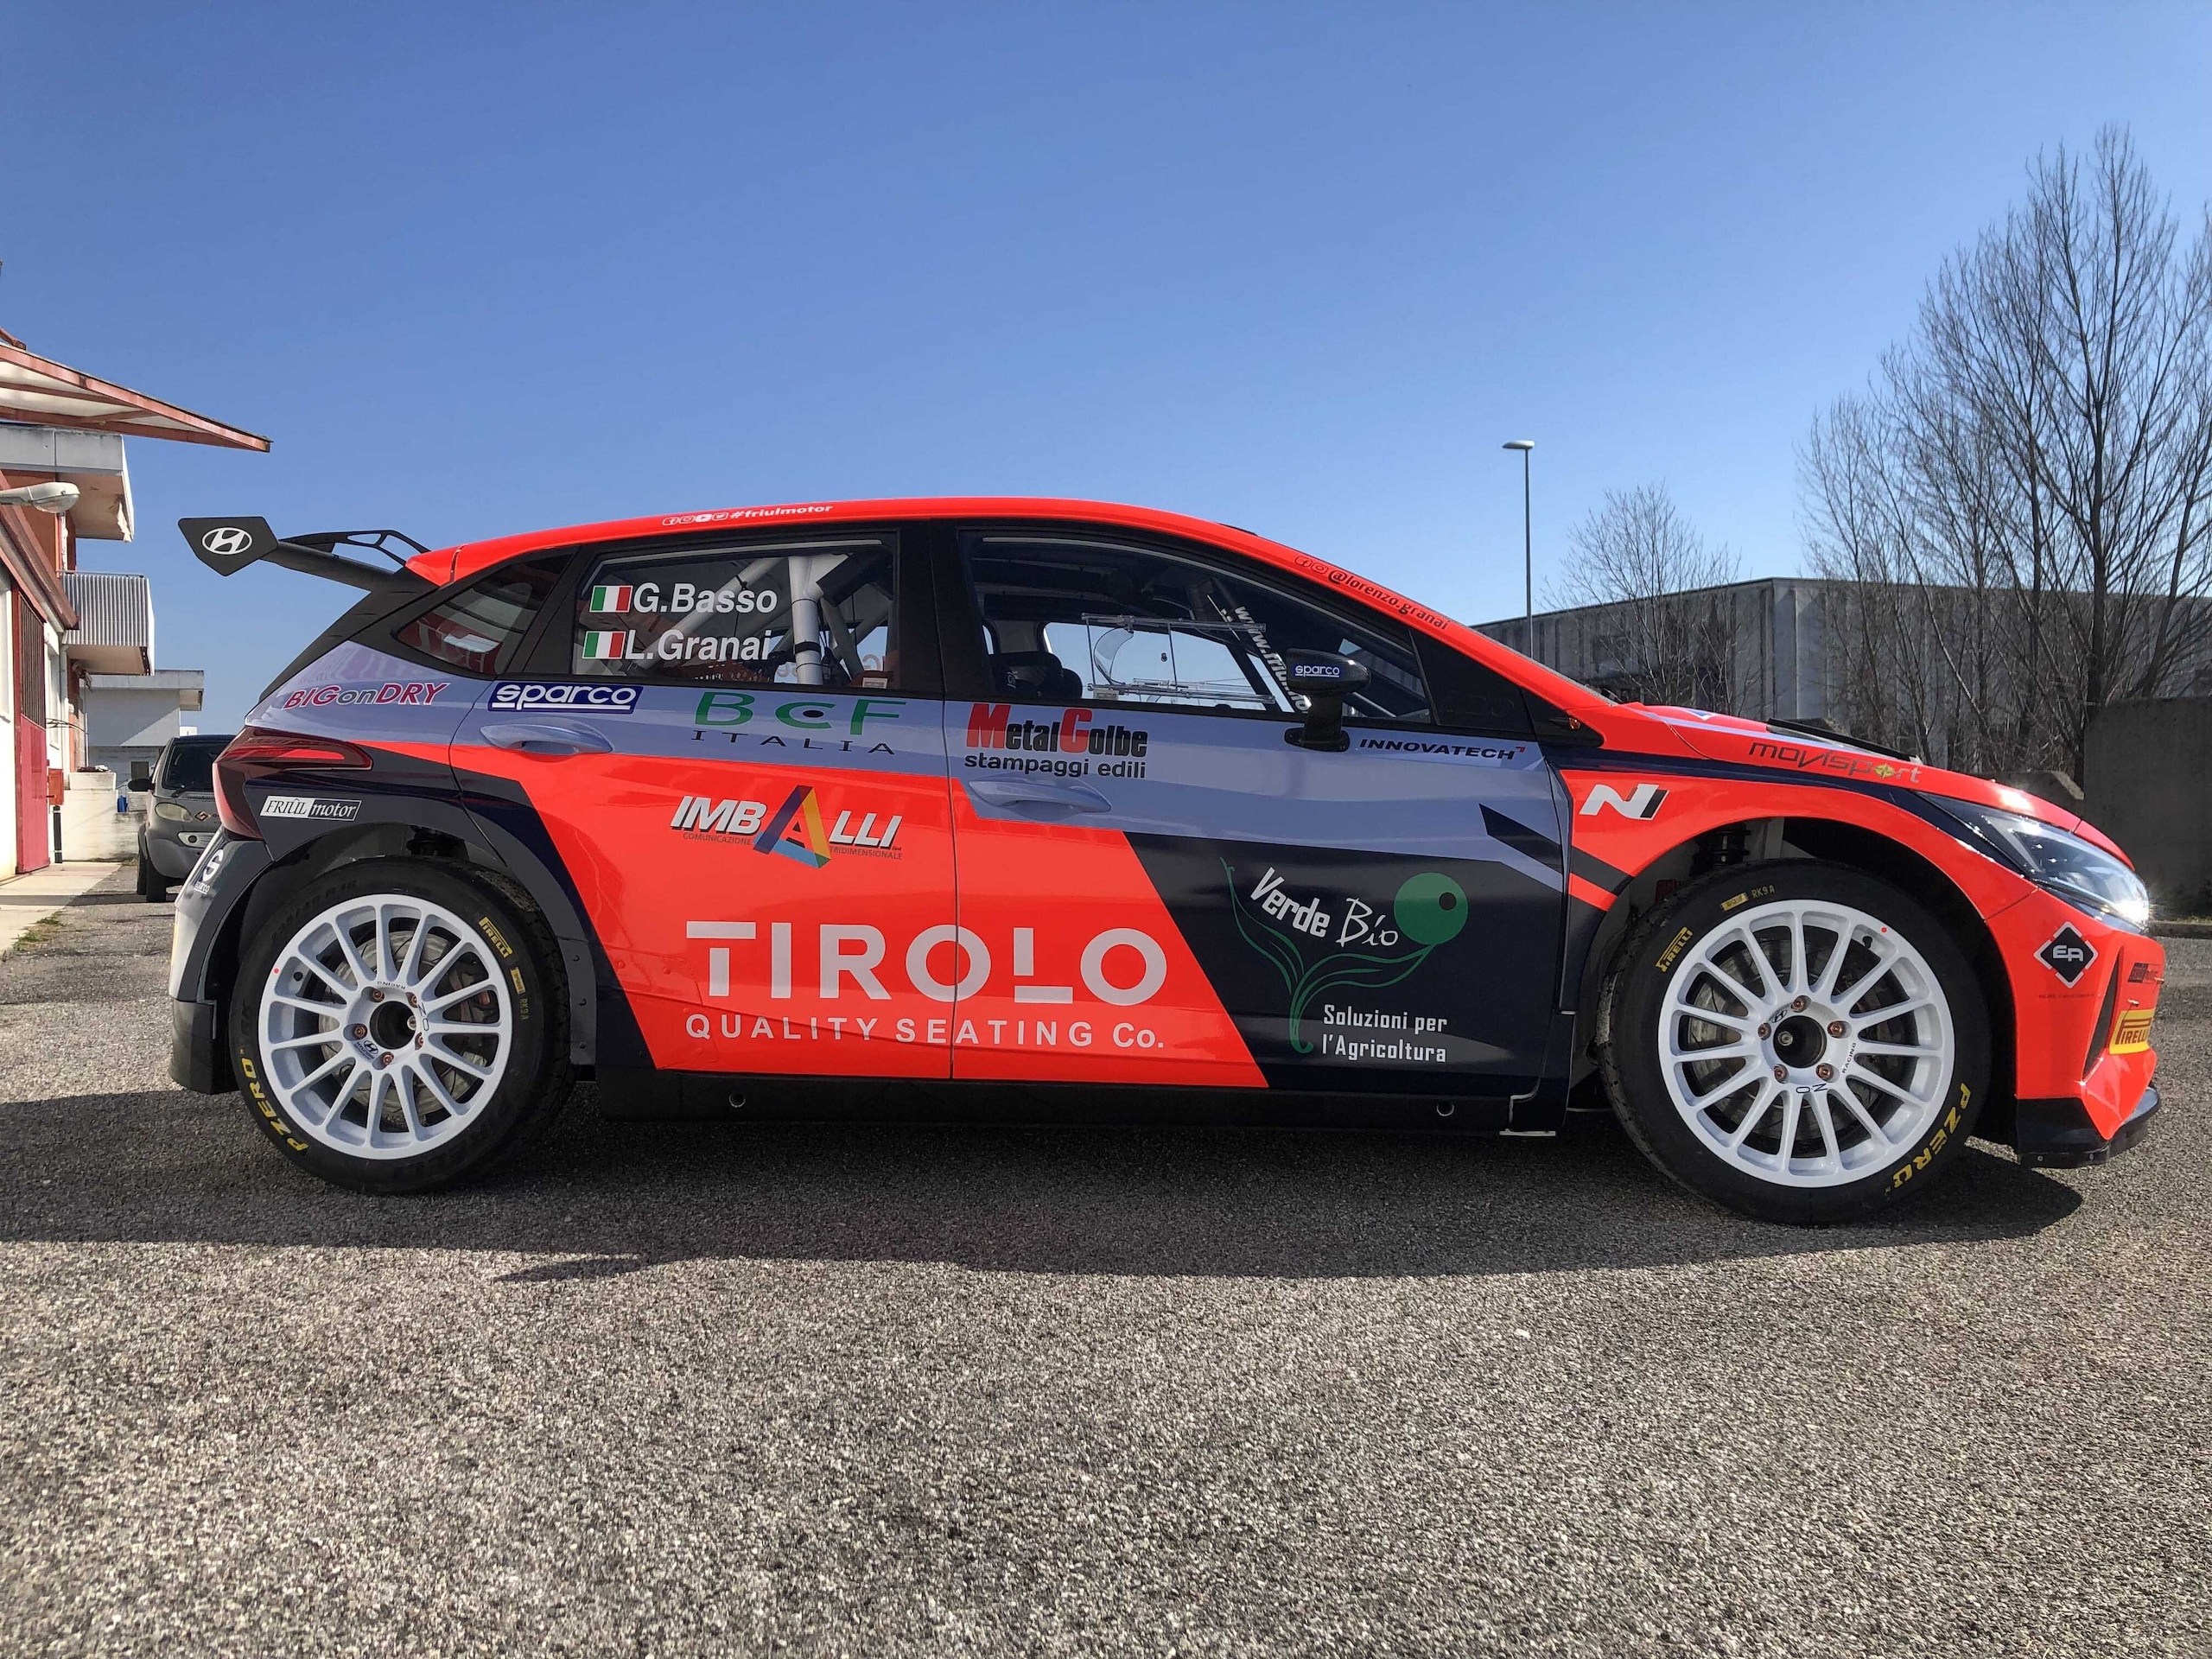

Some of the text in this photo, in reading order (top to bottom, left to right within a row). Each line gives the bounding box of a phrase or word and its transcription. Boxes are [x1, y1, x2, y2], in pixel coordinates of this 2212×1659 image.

[730, 505, 834, 518] #friulmotor
[633, 582, 778, 613] G.Basso
[1328, 570, 1451, 629] @lorenzo.granai
[625, 629, 772, 661] L.Granai
[1294, 664, 1340, 677] sparco
[492, 684, 637, 711] sparco
[694, 691, 906, 735] BCF
[691, 729, 895, 755] ITALIA
[966, 702, 1148, 757] MetalColbe
[1359, 739, 1515, 760] INNOVATECH
[964, 753, 1146, 779] stampaggi edili
[310, 803, 357, 818] motor
[670, 785, 903, 868] IMBALLI
[683, 832, 752, 846] COMUNICAZIONE
[828, 846, 903, 860] TRIDIMENSIONALE
[1250, 867, 1398, 948] Verde Bio
[479, 916, 513, 958] PIRELLI
[1655, 926, 1694, 973] PIRELLI
[686, 921, 1167, 1007] TIROLO
[685, 1014, 1164, 1049] QUALITY SEATING Co.
[1323, 1004, 1447, 1034] Soluzioni per
[1322, 1033, 1446, 1063] l'Agricoltura
[1841, 1042, 1857, 1074] RACING
